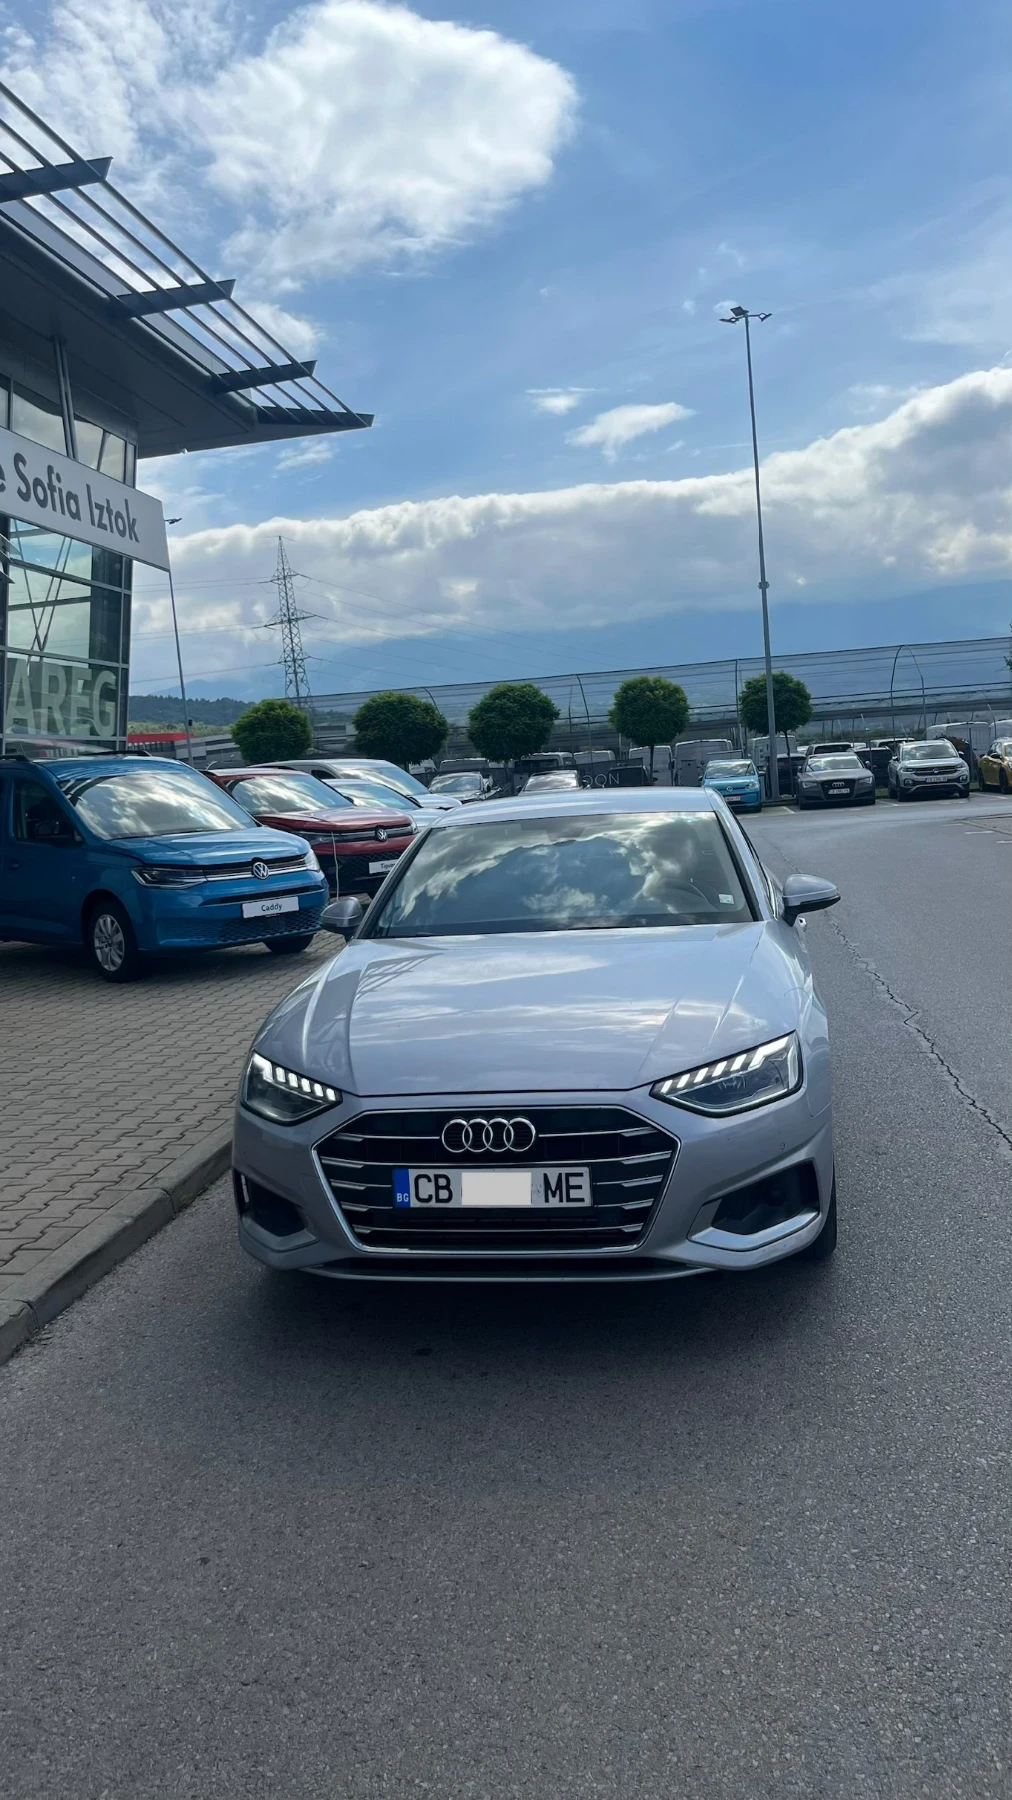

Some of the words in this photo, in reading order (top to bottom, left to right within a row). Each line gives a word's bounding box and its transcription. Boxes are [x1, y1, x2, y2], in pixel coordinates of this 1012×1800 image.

[13, 452, 82, 521] Sofia
[86, 483, 140, 543] Iztok
[6, 659, 117, 737] AREG
[261, 902, 282, 912] Caddy
[396, 1192, 409, 1203] BG
[413, 1173, 453, 1204] CB
[543, 1172, 585, 1203] ME
